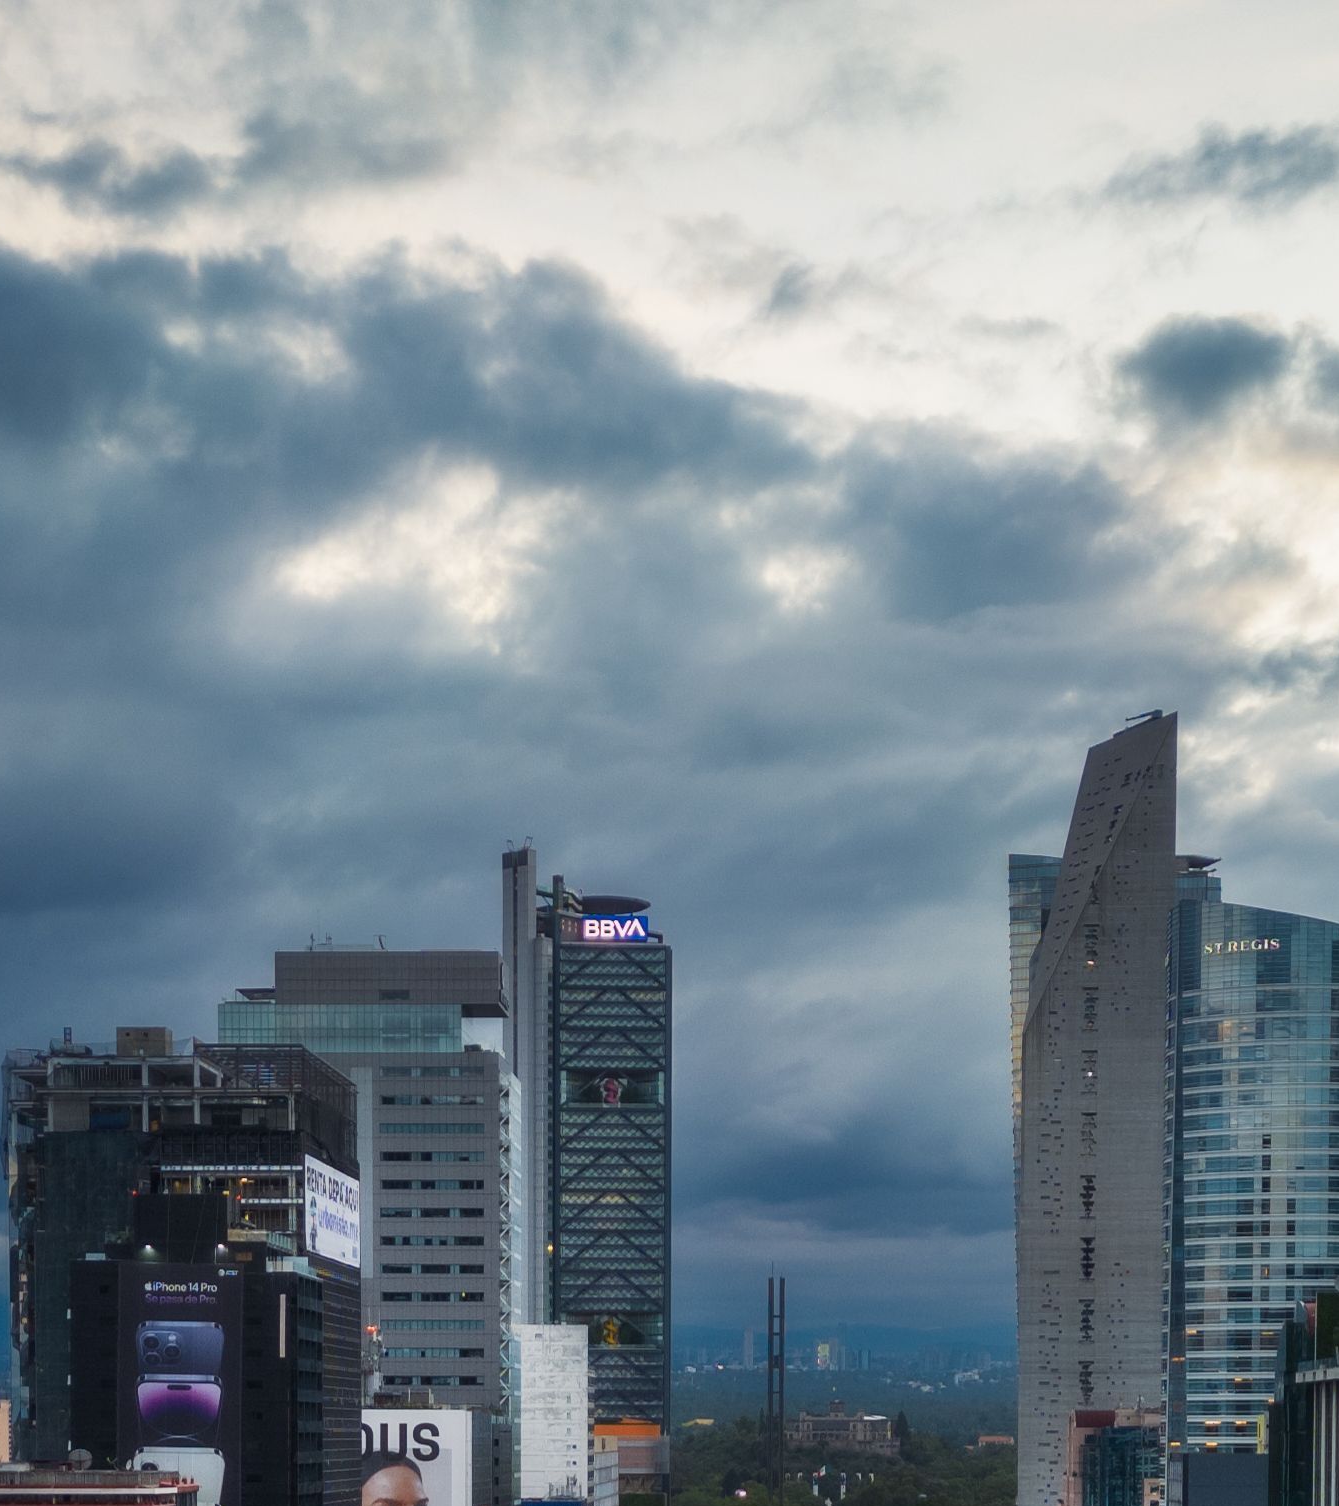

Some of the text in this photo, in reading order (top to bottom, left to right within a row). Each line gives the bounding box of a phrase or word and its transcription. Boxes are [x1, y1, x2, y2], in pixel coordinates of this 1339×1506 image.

[584, 918, 646, 938] BBVA
[1227, 938, 1280, 953] REGIS
[306, 1165, 327, 1198] RENTA
[152, 1281, 218, 1292] iPhone 14 Pro
[184, 1294, 198, 1303] de
